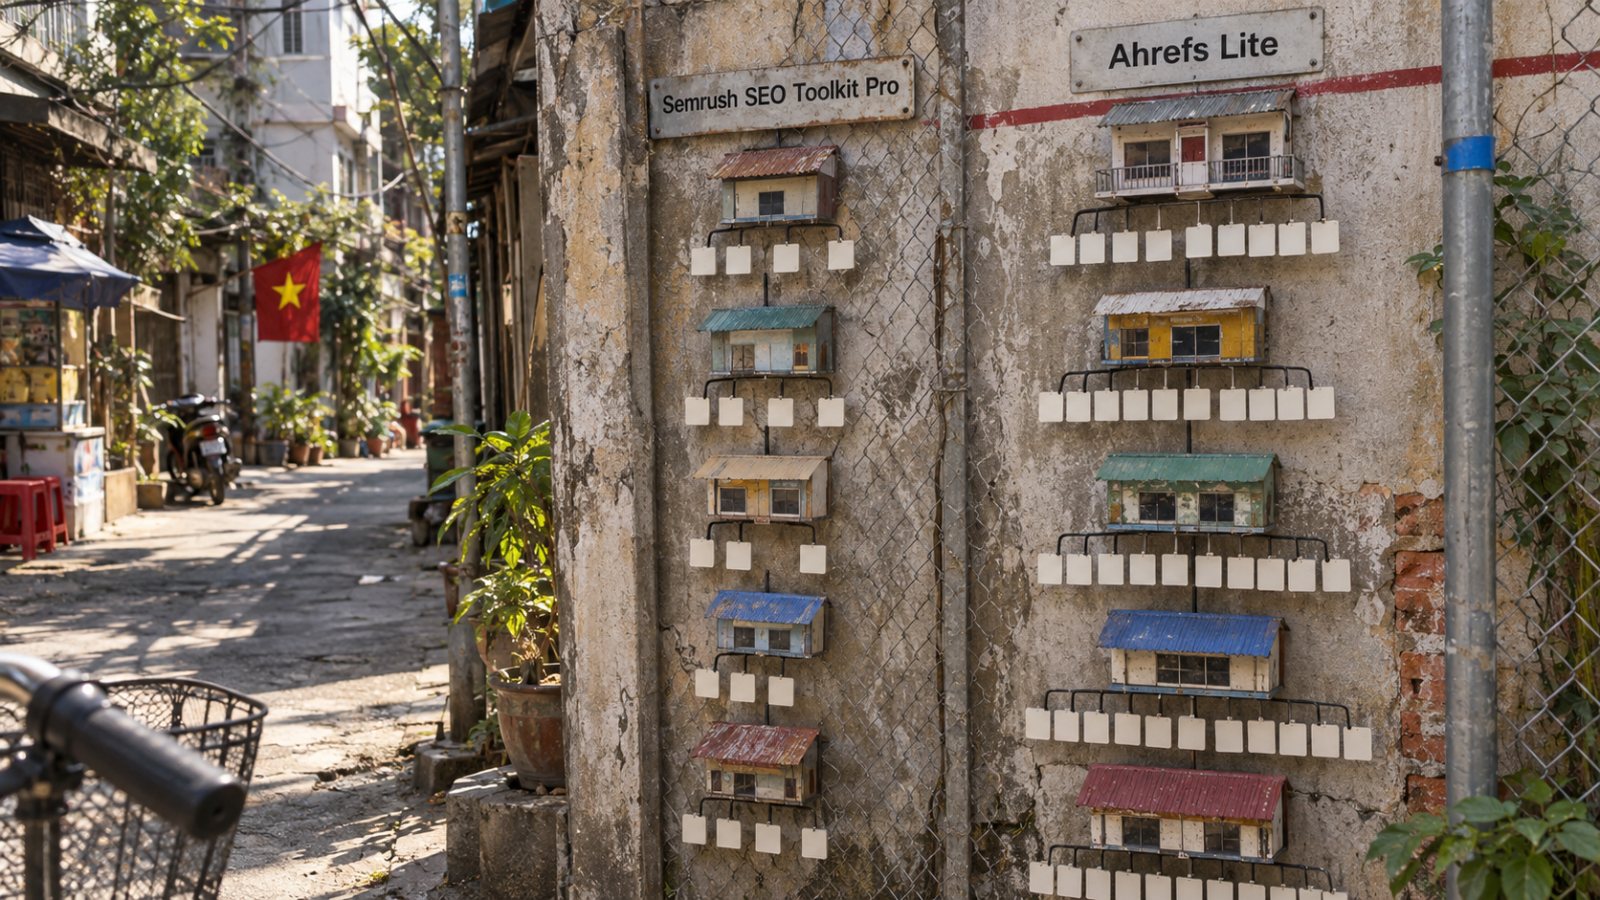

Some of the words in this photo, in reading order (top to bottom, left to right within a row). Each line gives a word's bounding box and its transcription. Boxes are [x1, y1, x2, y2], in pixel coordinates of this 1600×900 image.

[1108, 36, 1209, 70] Ahrefs
[1220, 31, 1279, 60] Lite
[662, 89, 738, 114] Semrush
[744, 84, 786, 107] SEO
[793, 79, 859, 102] Toolkit
[865, 77, 899, 97] Pro
